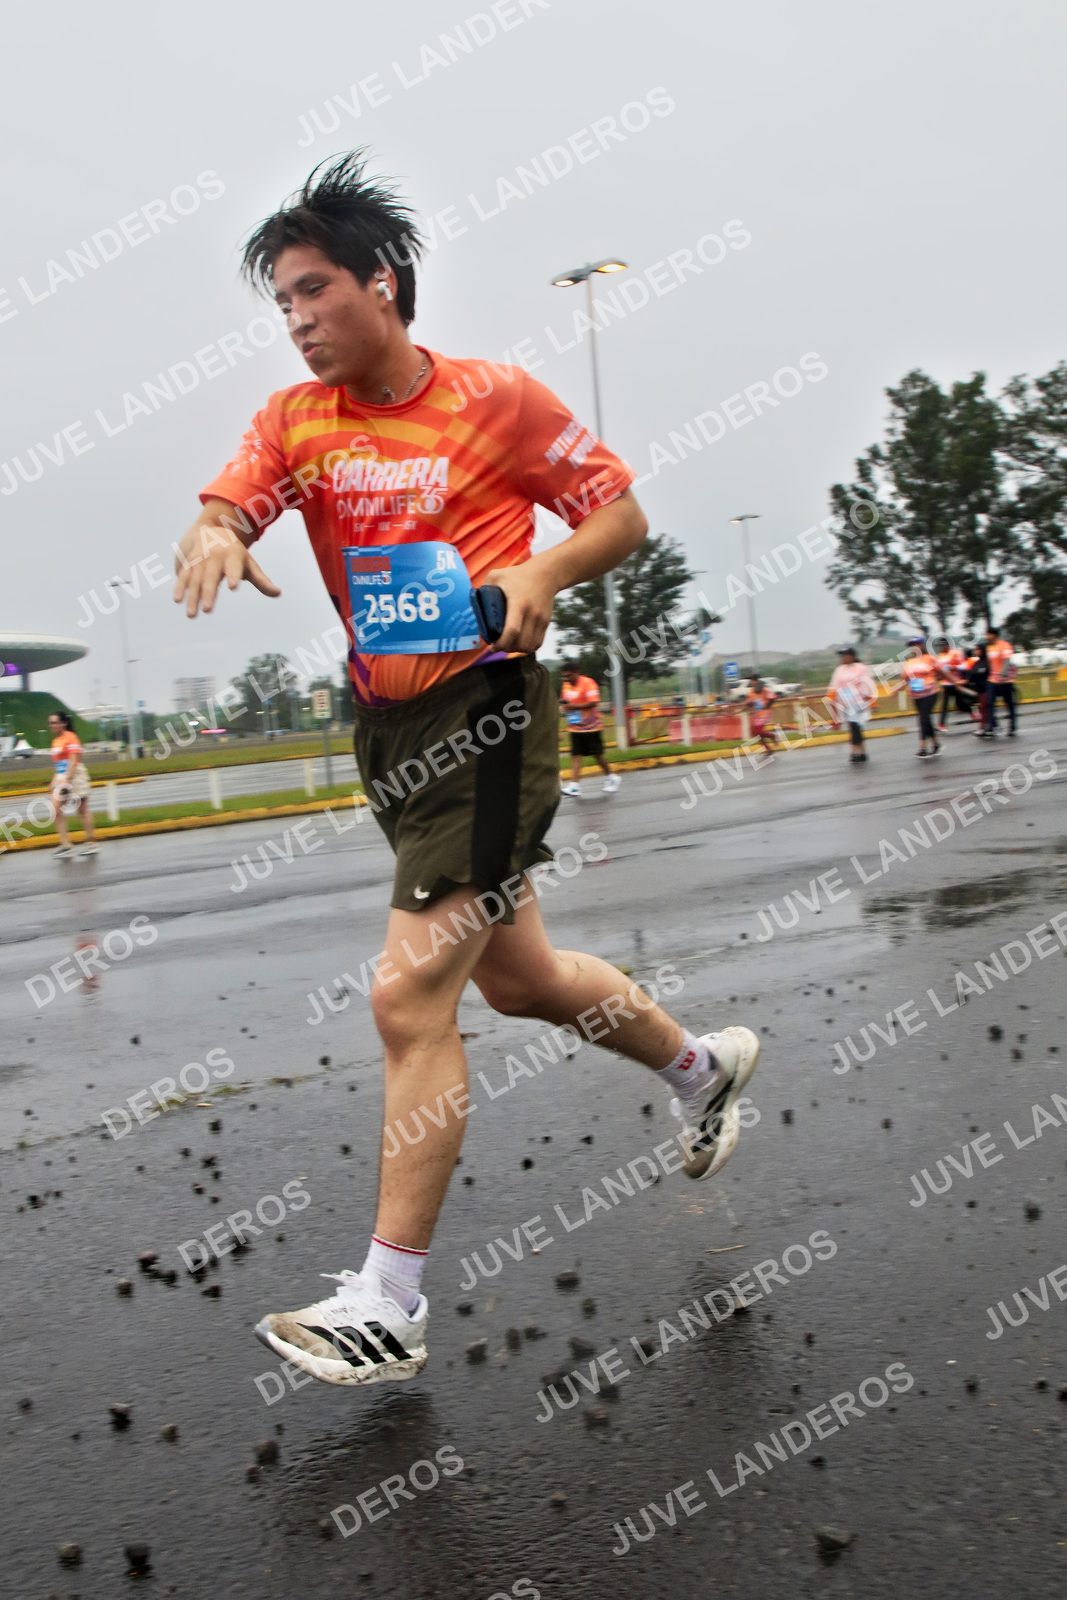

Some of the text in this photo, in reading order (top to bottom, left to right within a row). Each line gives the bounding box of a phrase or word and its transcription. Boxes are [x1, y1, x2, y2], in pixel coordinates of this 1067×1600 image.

[332, 456, 450, 493] CARRERA
[436, 549, 457, 571] 5K
[363, 591, 440, 624] 2568
